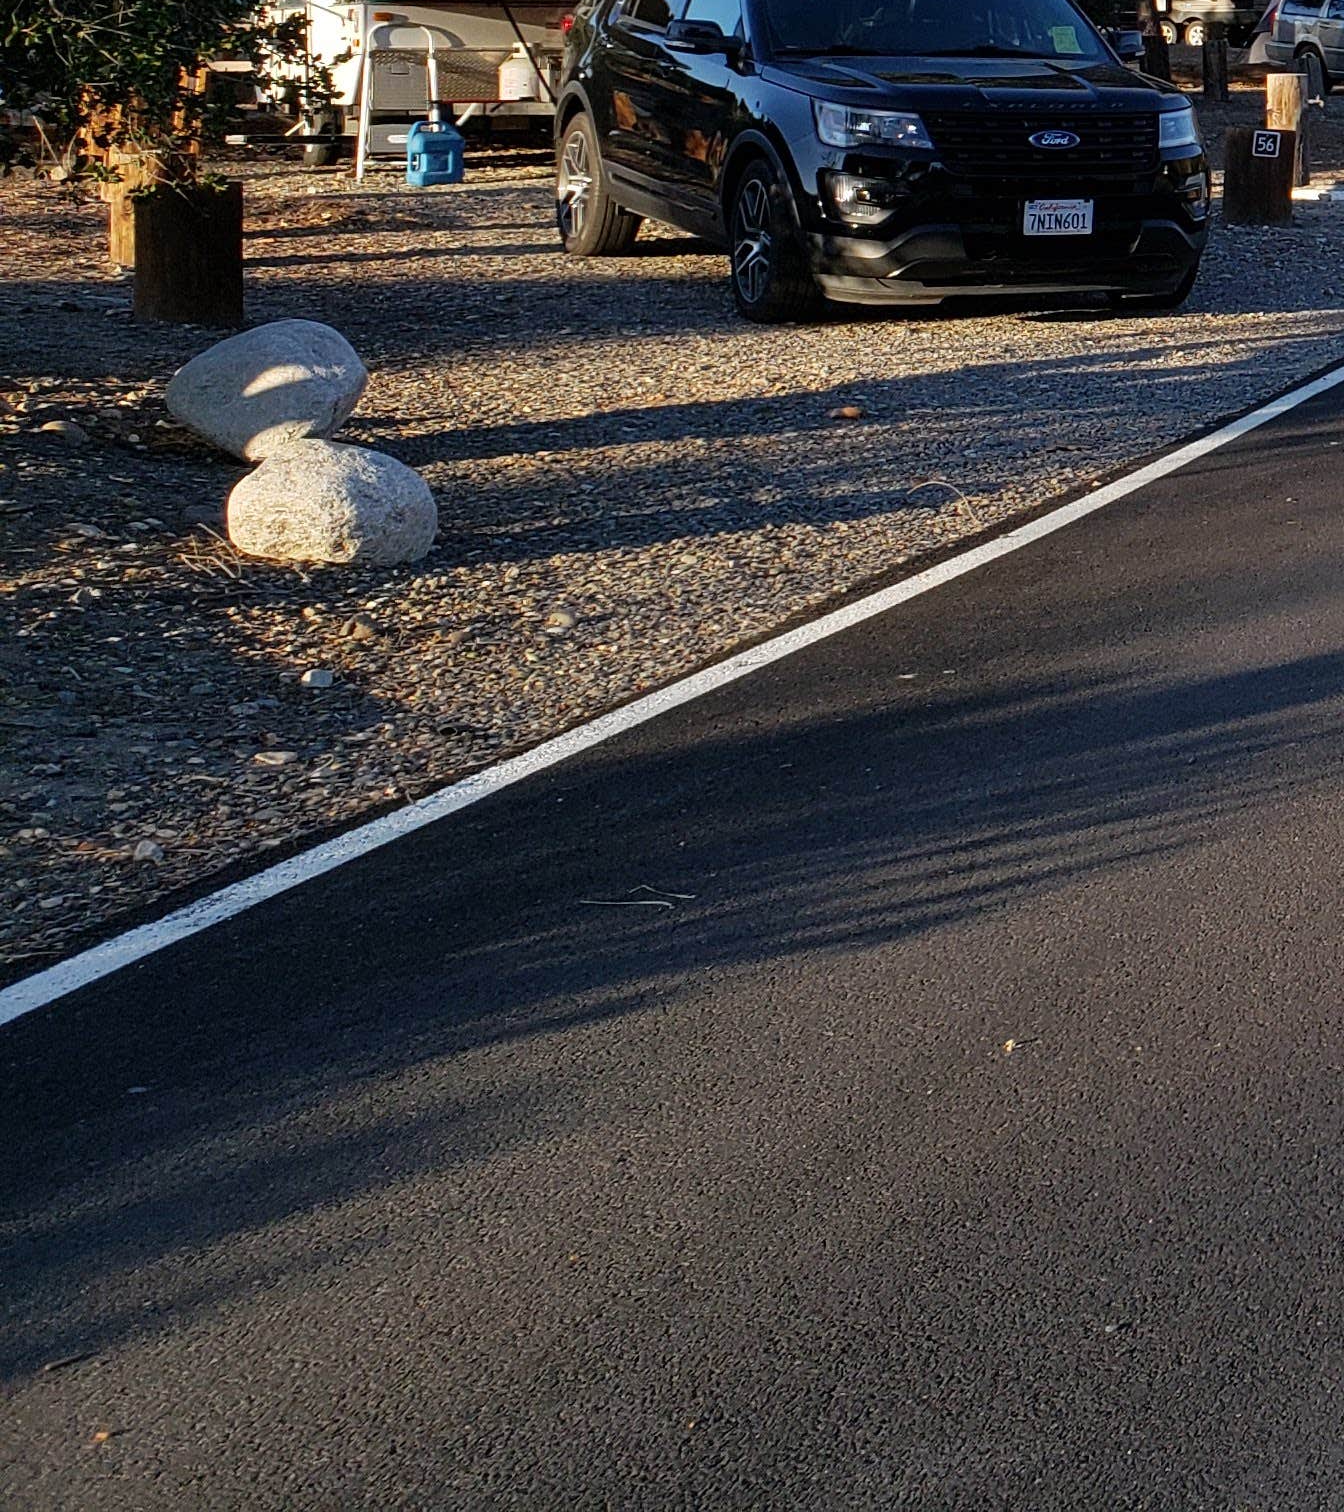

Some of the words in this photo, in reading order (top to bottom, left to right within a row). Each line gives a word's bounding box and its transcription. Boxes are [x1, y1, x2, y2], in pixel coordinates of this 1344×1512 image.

[1041, 133, 1070, 145] Ford
[1257, 136, 1275, 152] 56
[1028, 213, 1088, 231] 7NIN601
